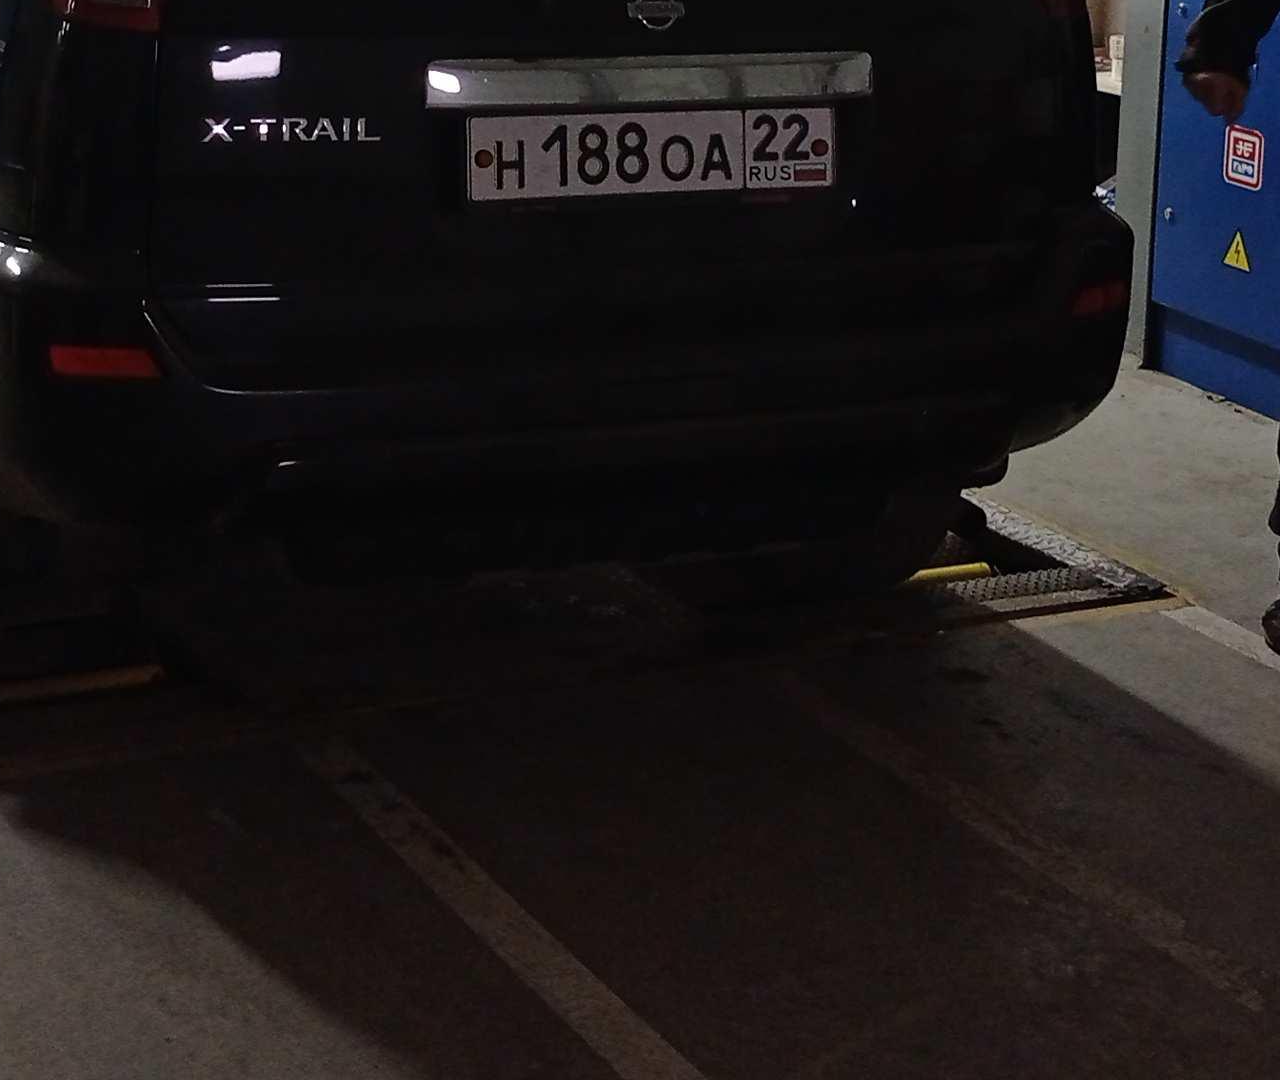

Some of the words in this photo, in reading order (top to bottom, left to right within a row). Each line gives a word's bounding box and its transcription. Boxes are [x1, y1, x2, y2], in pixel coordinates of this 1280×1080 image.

[200, 117, 382, 143] X-TRAIL
[752, 113, 810, 162] 22
[749, 166, 792, 182] RUS
